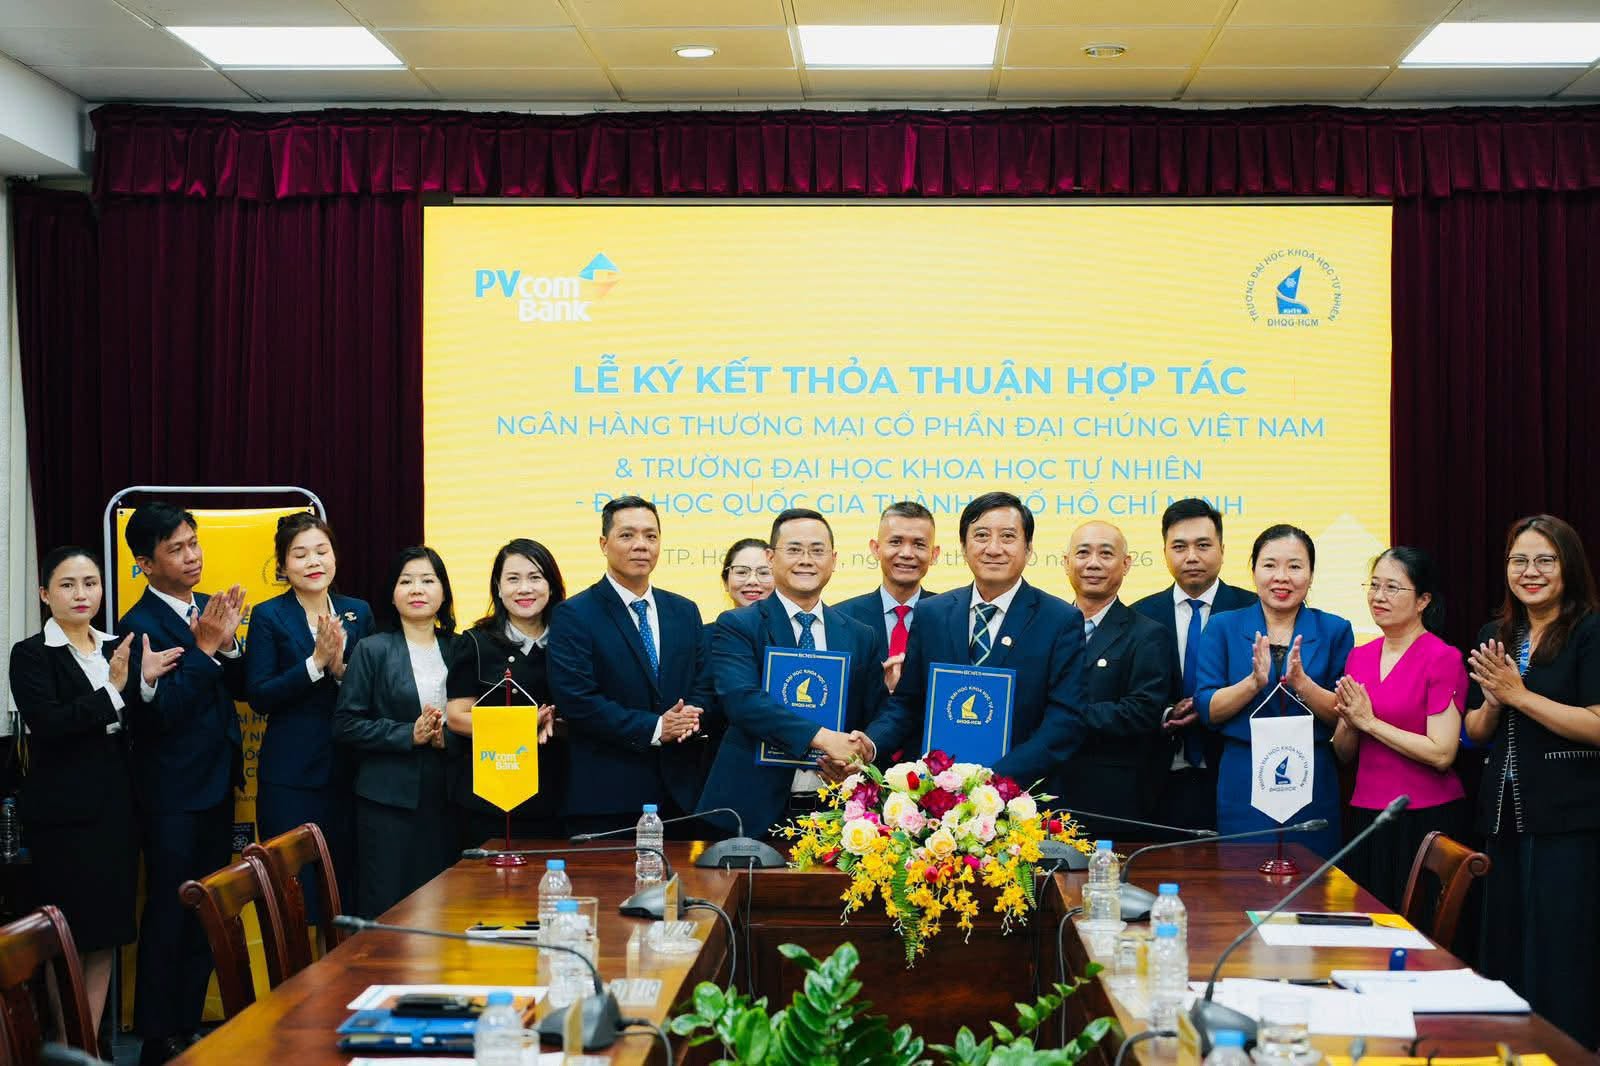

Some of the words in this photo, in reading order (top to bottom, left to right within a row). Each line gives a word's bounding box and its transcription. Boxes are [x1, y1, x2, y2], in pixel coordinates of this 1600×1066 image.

[1287, 249, 1315, 260] KHOA
[475, 269, 581, 298] PVcom
[518, 299, 592, 321] Bank
[573, 353, 620, 395] LỄ
[633, 359, 685, 395] KÝ
[696, 356, 772, 395] KẾT
[782, 356, 899, 396] THỎA
[908, 358, 1053, 401] THUẬN
[1067, 362, 1157, 401] HỢP
[1167, 359, 1247, 396] TÁC
[497, 411, 579, 436] NGÂN
[589, 411, 672, 436] HÀNG
[680, 413, 804, 437] THƯƠNG
[814, 415, 866, 441] MẠI
[924, 411, 1006, 437] PHẦN
[1014, 415, 1064, 442] ĐẠI
[1073, 412, 1179, 438] CHÚNG
[1188, 412, 1250, 442] VIỆT
[1258, 417, 1325, 438] NAM
[615, 458, 634, 479] &
[640, 453, 763, 480] TRƯỜNG
[770, 458, 821, 483] ĐẠI
[830, 458, 894, 483] HỌC
[902, 458, 986, 480] KHOA
[994, 458, 1057, 483] HỌC
[1065, 456, 1104, 484] TỰ
[1111, 455, 1203, 480] NHIÊN
[652, 492, 714, 517] HỌC
[722, 487, 808, 517] QUỐC
[816, 493, 866, 514] GIA
[1108, 488, 1158, 516] CHÍ
[664, 549, 694, 566] TP.
